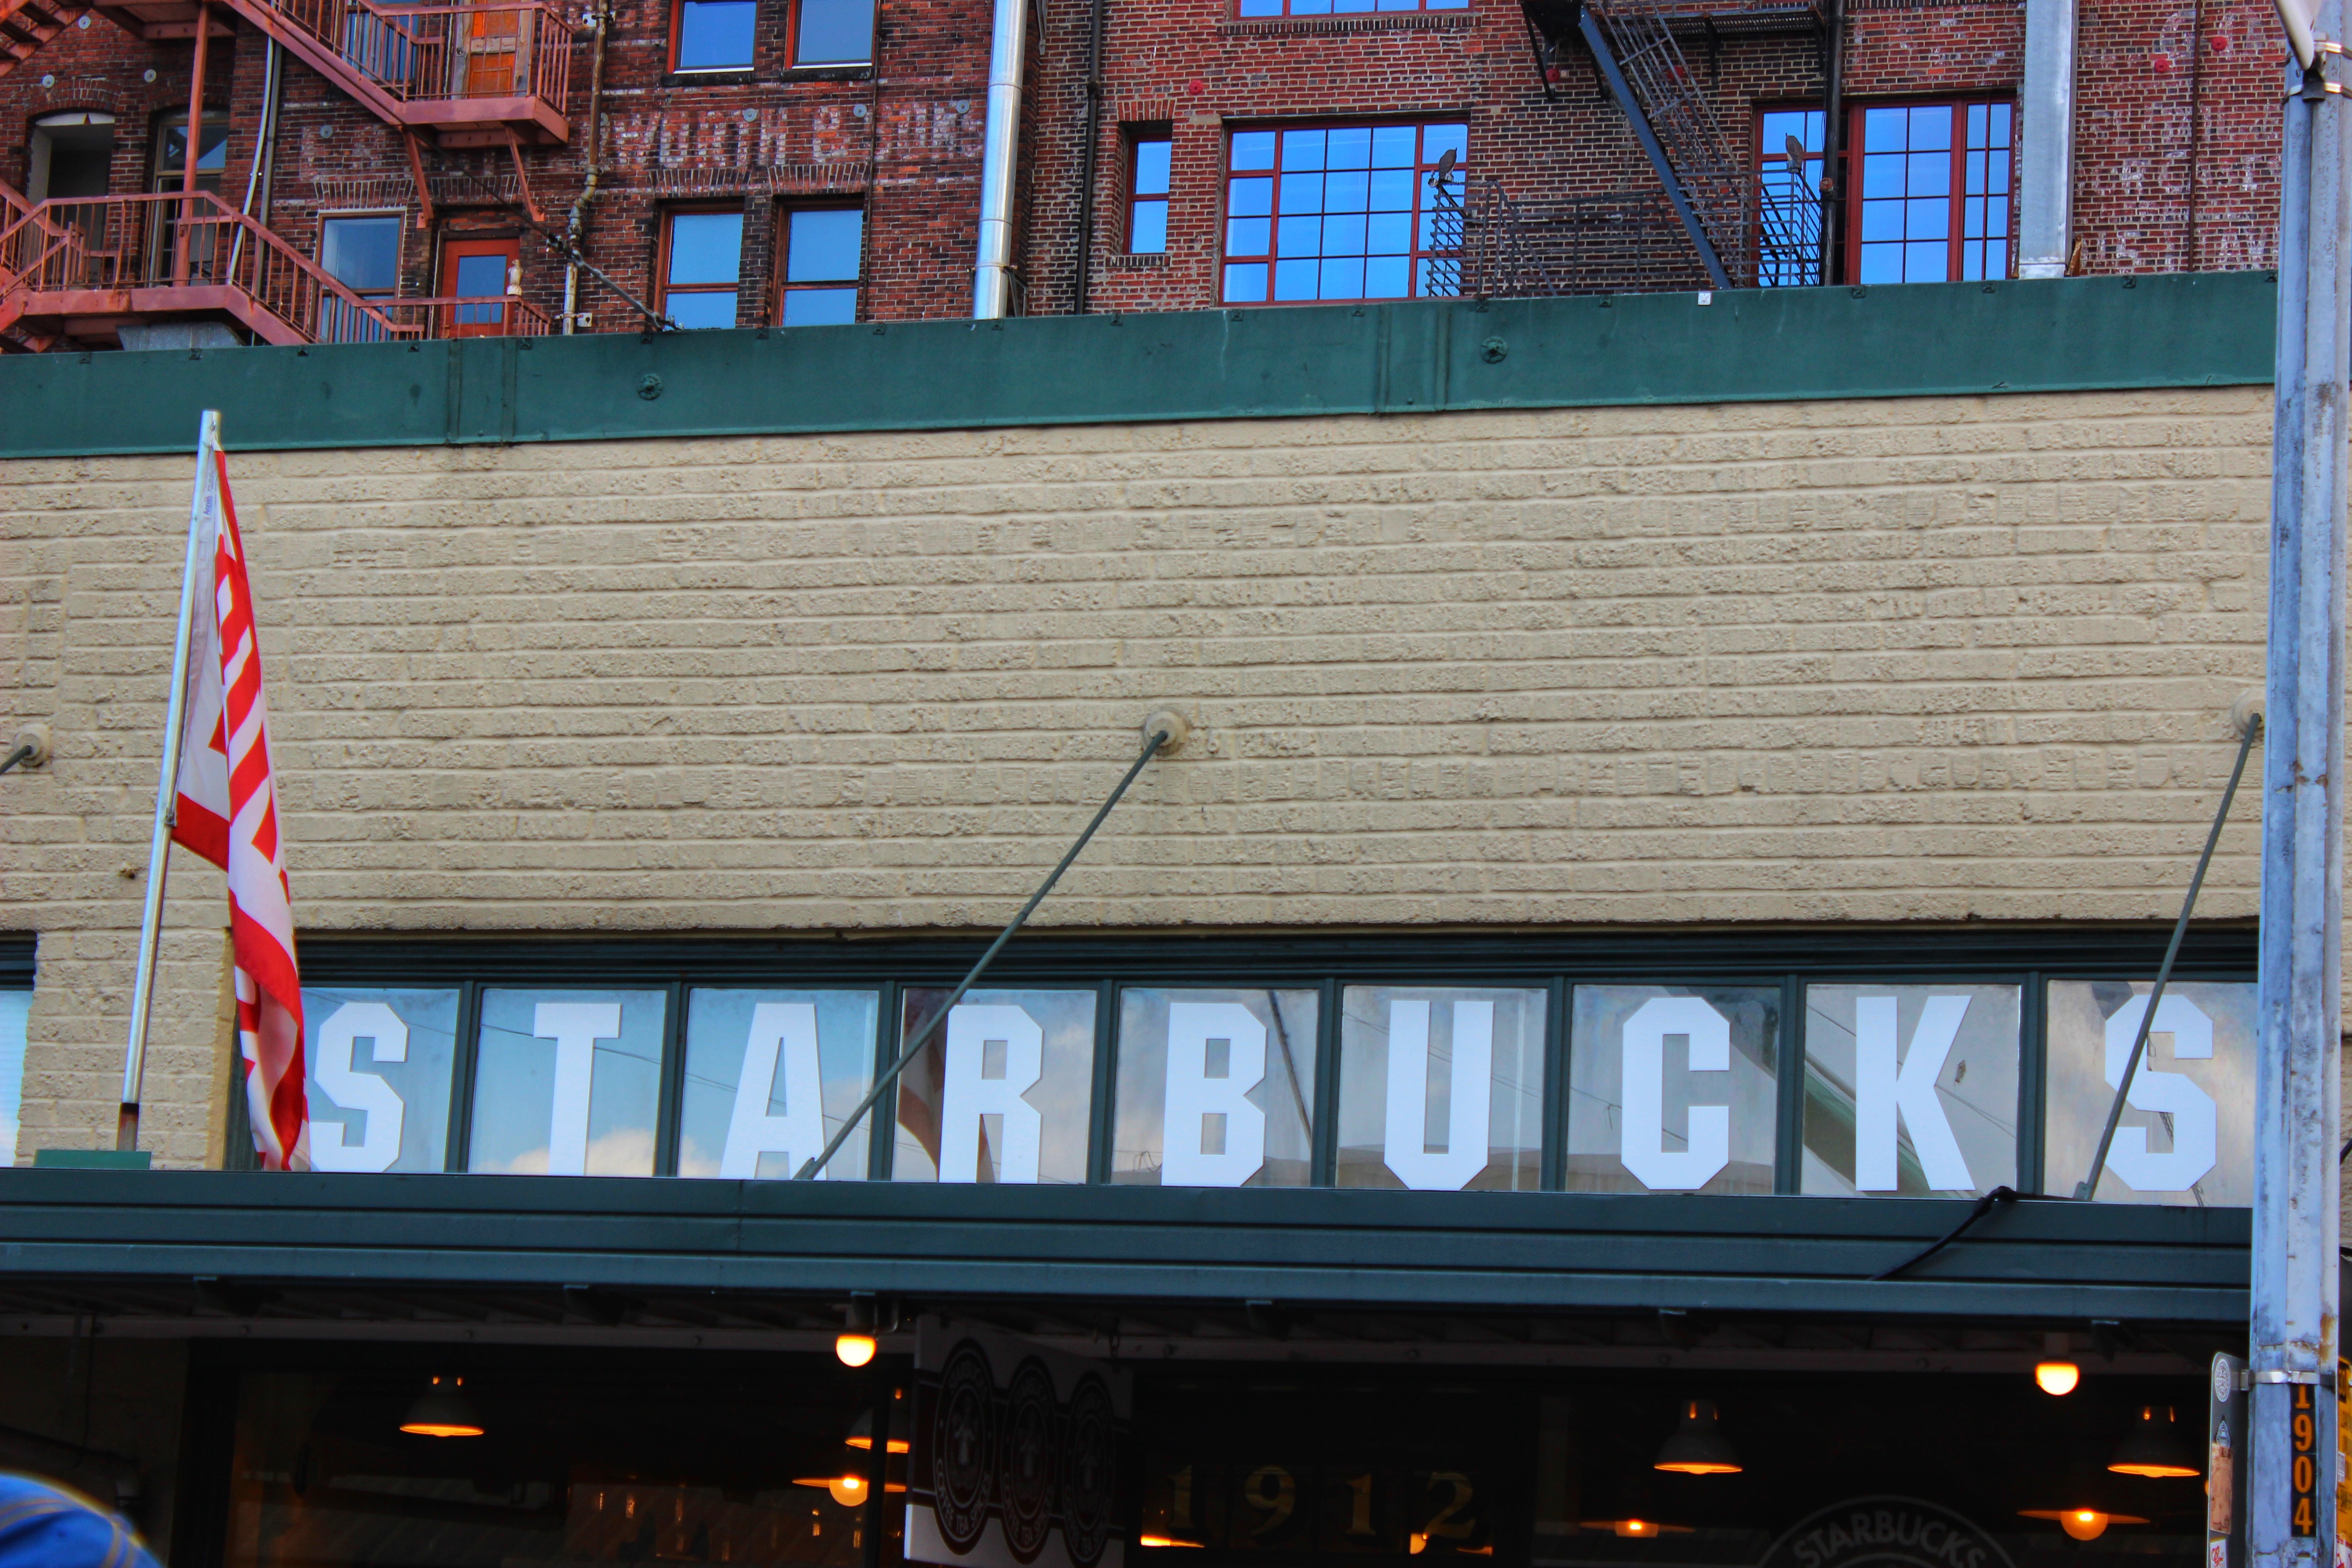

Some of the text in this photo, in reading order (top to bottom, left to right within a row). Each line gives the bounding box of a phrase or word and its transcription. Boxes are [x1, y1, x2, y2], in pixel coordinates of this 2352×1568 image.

[310, 995, 2217, 1192] STARBUCKS
[937, 1458, 990, 1535] COFFEE TEA SPICES
[2293, 1384, 2314, 1535] 1904
[1021, 1527, 1034, 1547] TEA
[1793, 1510, 1986, 1568] STARBUCKS
